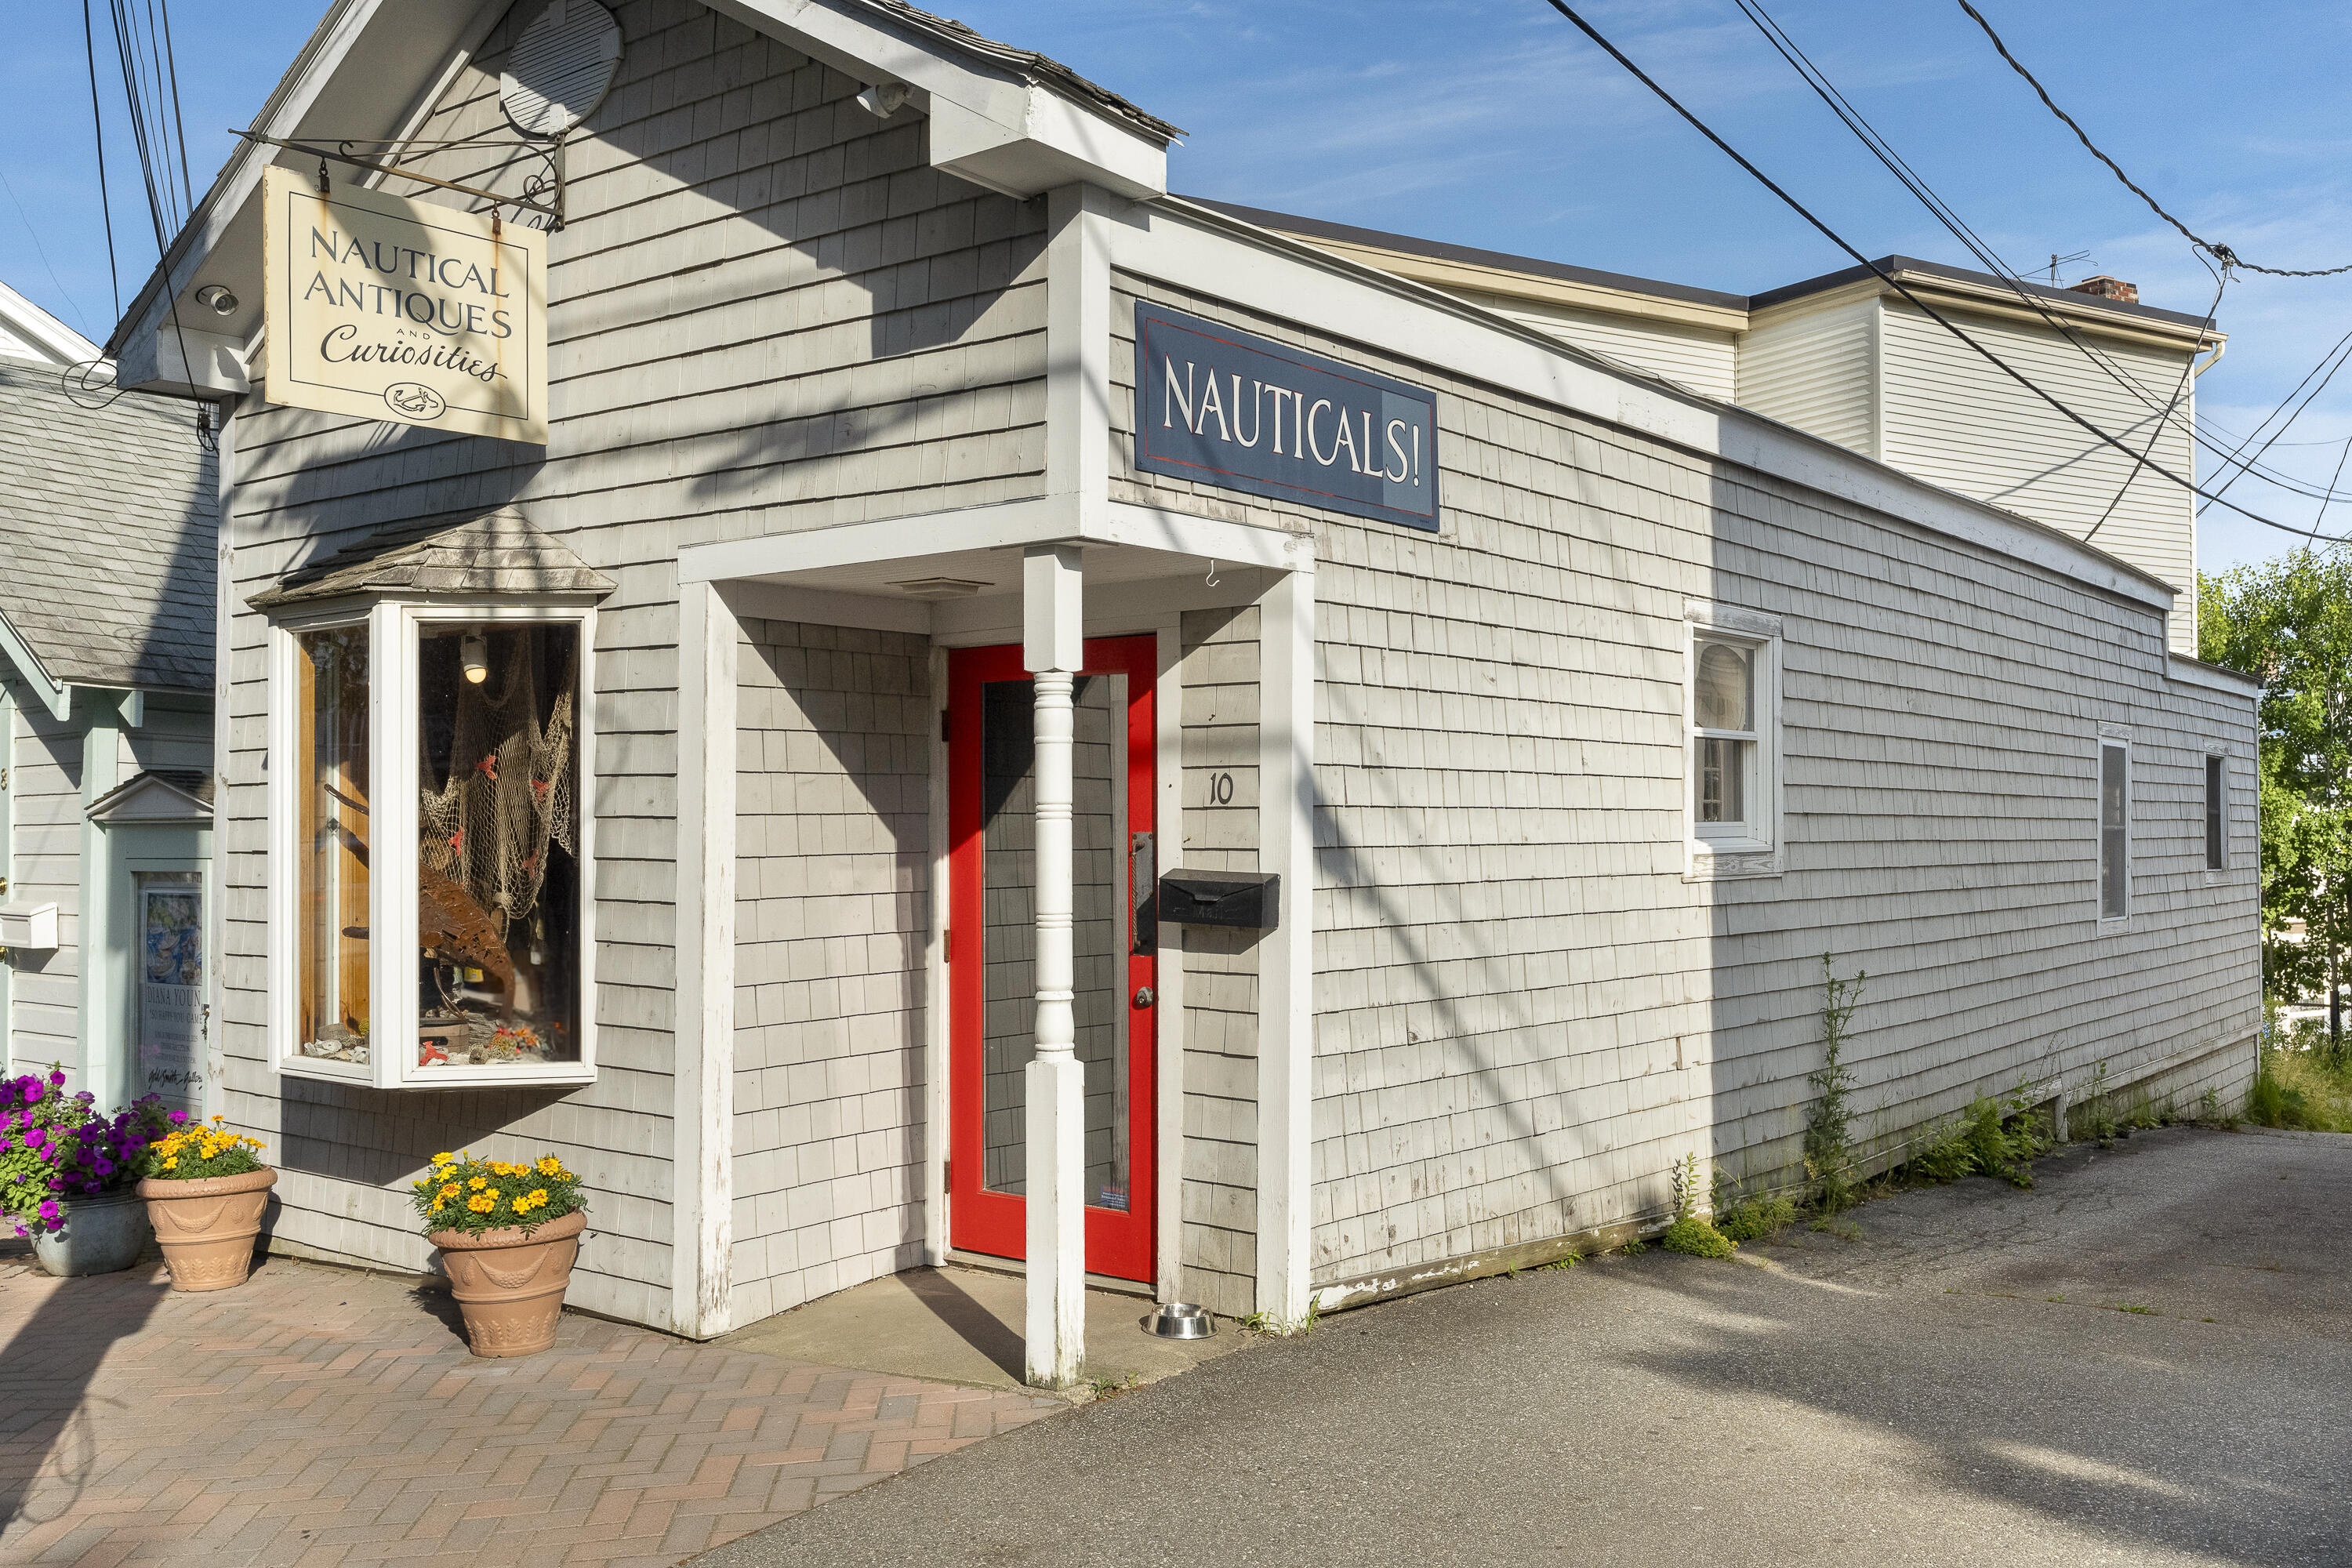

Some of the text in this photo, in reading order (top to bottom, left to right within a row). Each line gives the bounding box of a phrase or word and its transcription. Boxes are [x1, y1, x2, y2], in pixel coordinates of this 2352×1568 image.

[311, 225, 510, 298] NAUTICAL
[303, 270, 512, 339] ANTIQUES
[396, 327, 431, 341] AND
[320, 323, 508, 383] Curiosities
[1162, 351, 1421, 488] NAUTICALS!
[1210, 772, 1234, 805] 10
[147, 986, 171, 1005] DIANA
